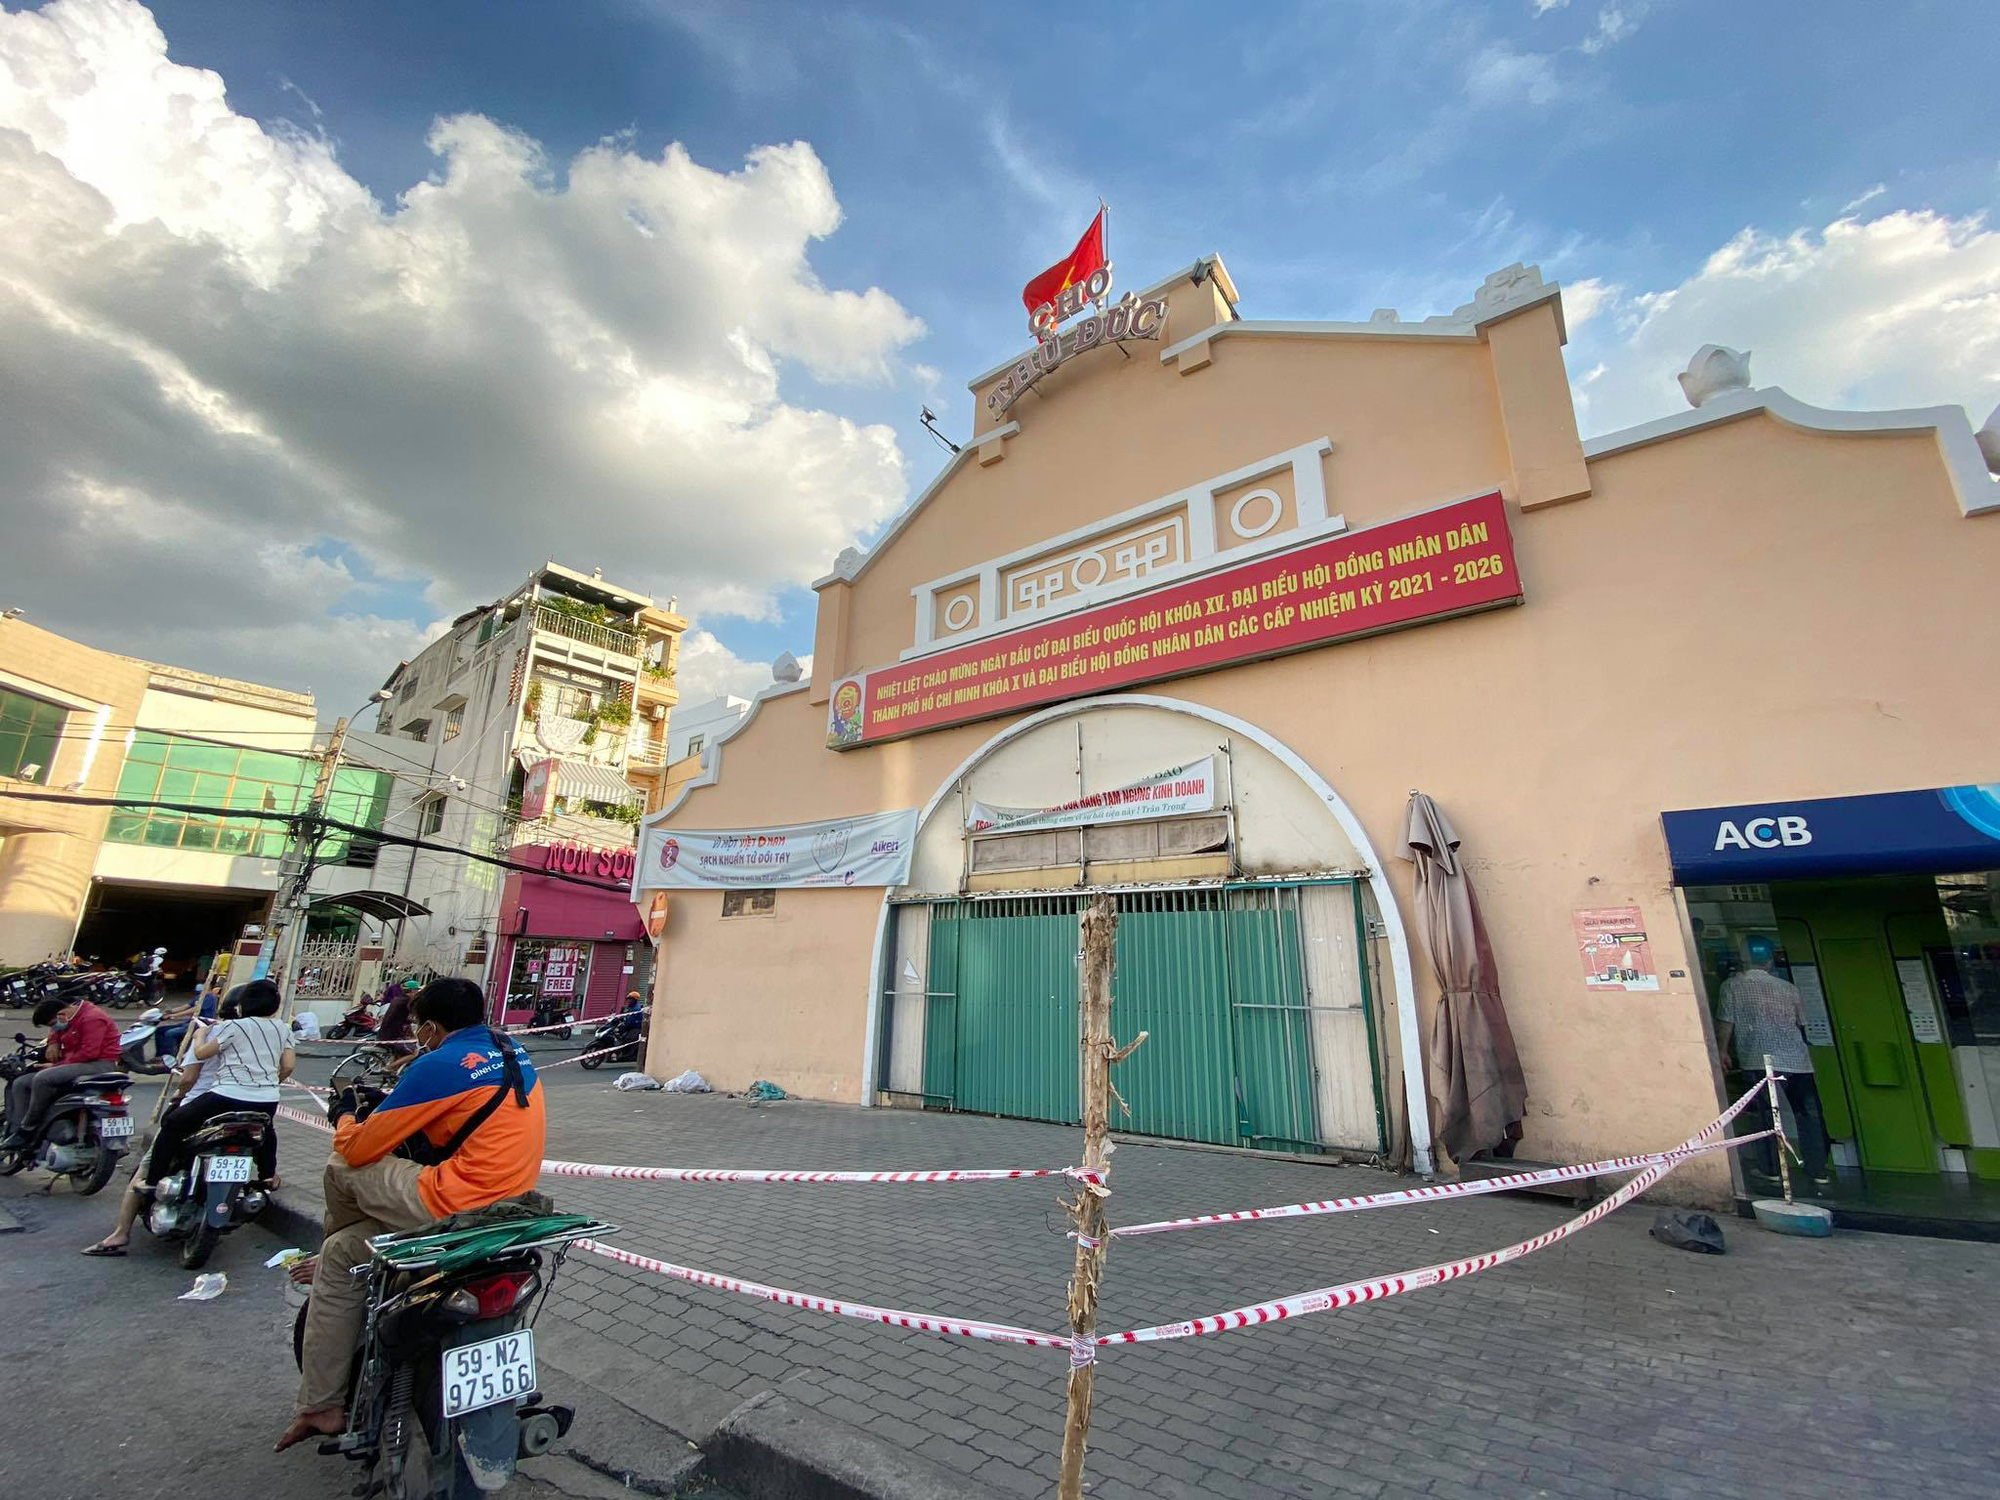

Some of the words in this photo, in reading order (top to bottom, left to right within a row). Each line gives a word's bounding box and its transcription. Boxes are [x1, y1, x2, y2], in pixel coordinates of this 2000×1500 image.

[1028, 259, 1113, 335] CHỢ
[1074, 291, 1165, 351] ĐỨC
[877, 681, 902, 701] NHIỆT
[903, 676, 921, 697] LIỆT
[923, 668, 947, 688] CHÀO
[950, 661, 978, 682] MỪNG
[981, 653, 1008, 674] NGÀY
[1034, 640, 1050, 660] CỬ
[1051, 637, 1070, 657] ĐẠI
[1073, 625, 1100, 650] BIỂU
[1103, 616, 1136, 643] QUỐC
[1140, 610, 1161, 633] HỘI
[1165, 601, 1202, 626] KHÓA
[1232, 585, 1258, 609] ĐẠI
[1261, 569, 1298, 600] BIỂU
[1302, 563, 1331, 589] HỘI
[1335, 551, 1384, 581] ĐỒNG
[1388, 535, 1442, 566] NHÂN
[1445, 522, 1489, 551] DÂN
[872, 702, 900, 724] THÀNH
[902, 695, 920, 717] PHỐ
[936, 688, 951, 708] CHÍ
[954, 685, 980, 704] MINH
[983, 676, 1010, 699] KHÓA
[1011, 675, 1020, 691] X
[1022, 669, 1037, 688] VÀ
[1039, 664, 1058, 686] ĐẠI
[1061, 654, 1087, 680] BIỂU
[1090, 651, 1111, 674] HỘI
[1114, 642, 1149, 666] ĐỒNG
[1152, 632, 1191, 658] NHÂN
[1194, 624, 1225, 648] DÂN
[1228, 615, 1259, 639] CÁC
[1263, 602, 1295, 631] CẤP
[1299, 591, 1357, 622] NHIỆM
[1360, 580, 1383, 607] KỲ
[1389, 571, 1433, 600] 2021
[1453, 554, 1504, 585] 2026
[1152, 783, 1173, 800] KINH
[1175, 779, 1205, 797] DOANH
[870, 840, 900, 853] Aiken
[1714, 816, 1813, 851] ACB
[546, 833, 594, 875] NÓN
[699, 856, 718, 869] SẠCH
[775, 852, 791, 864] TAY
[546, 962, 570, 976] GET
[572, 963, 577, 976] 1
[549, 948, 571, 961] BUY
[572, 948, 579, 961] 1
[546, 979, 572, 990] FREE
[215, 1158, 246, 1169] 59-X2
[457, 1338, 520, 1378] 59-N2
[449, 1364, 530, 1410] 975.66
